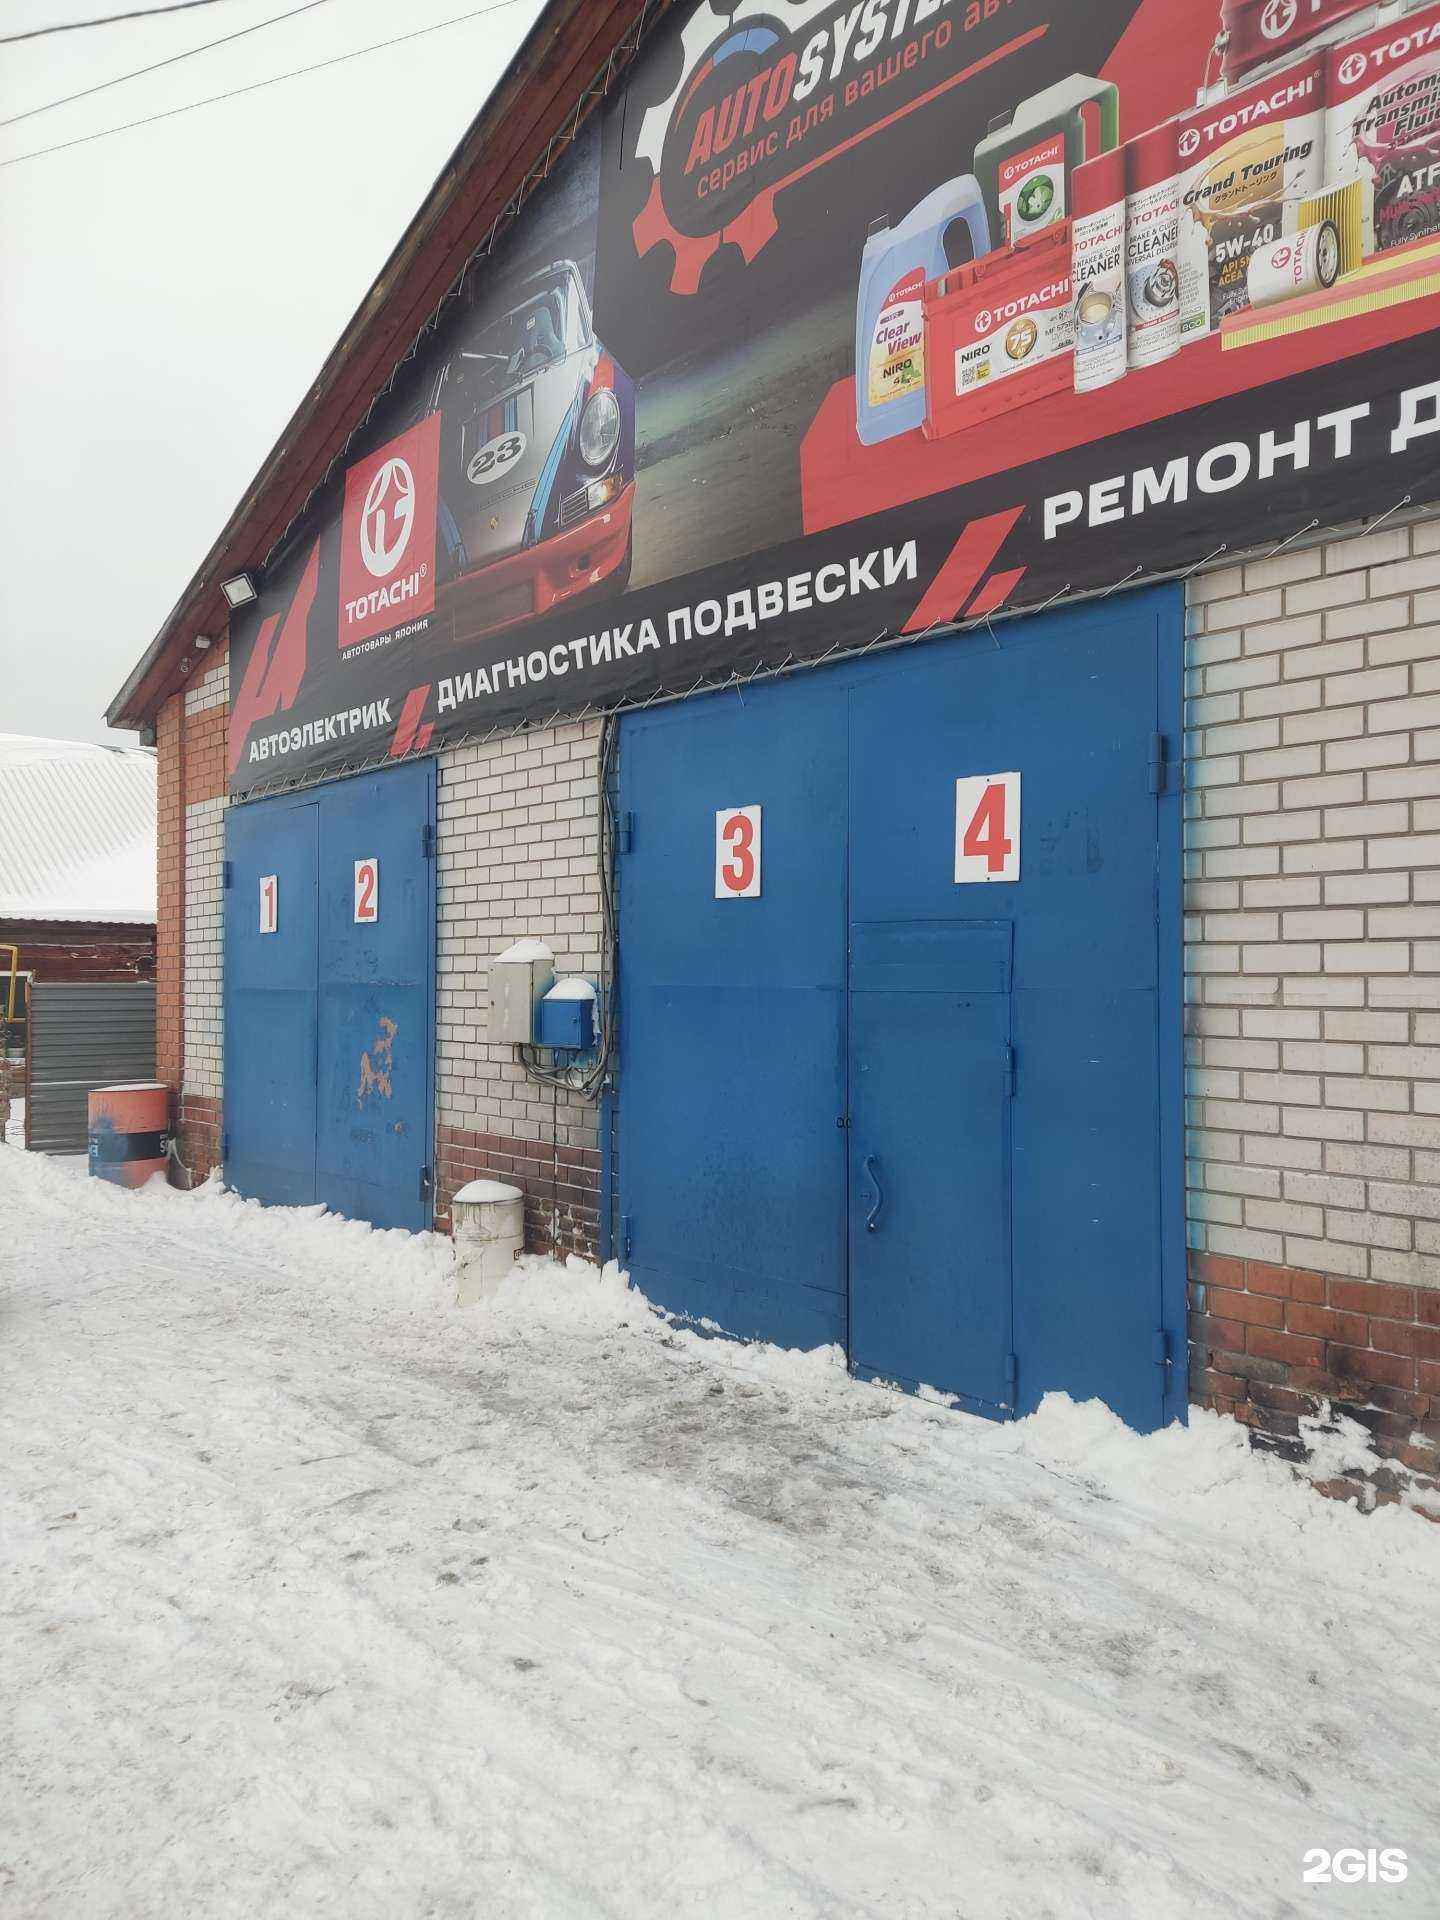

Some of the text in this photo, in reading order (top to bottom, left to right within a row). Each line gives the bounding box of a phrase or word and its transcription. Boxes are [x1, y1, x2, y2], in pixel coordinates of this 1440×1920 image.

[696, 130, 779, 199] сервис
[786, 94, 834, 150] для
[844, 20, 951, 107] вашего
[1203, 76, 1313, 141] TOTACHI
[1352, 88, 1440, 138] Transmi
[1366, 73, 1440, 115] Autom
[1013, 146, 1058, 173] TOTACHI
[1183, 171, 1236, 206] Grand
[1240, 140, 1314, 181] Touring
[1215, 223, 1274, 263] 5W-40
[993, 277, 1070, 322] TOTACHI
[876, 321, 910, 345] Clear
[888, 332, 922, 355] View
[961, 344, 991, 364] NIRO
[1010, 329, 1033, 352] 75
[883, 358, 912, 379] NIRO
[471, 437, 521, 480] 23
[1043, 402, 1371, 541] РЕМОНТ
[345, 572, 420, 624] TOTACHI
[342, 619, 429, 661] АВТОТОВАРЫ ЯПОНИЯ
[437, 539, 918, 713] ДИАГНОСТИКА ПОДВЕСКИ
[248, 698, 392, 763] АВТОЭЛЕКТРИК
[963, 783, 1012, 873] 4
[722, 815, 755, 891] 3
[264, 881, 274, 928] 1
[358, 864, 374, 918] 2
